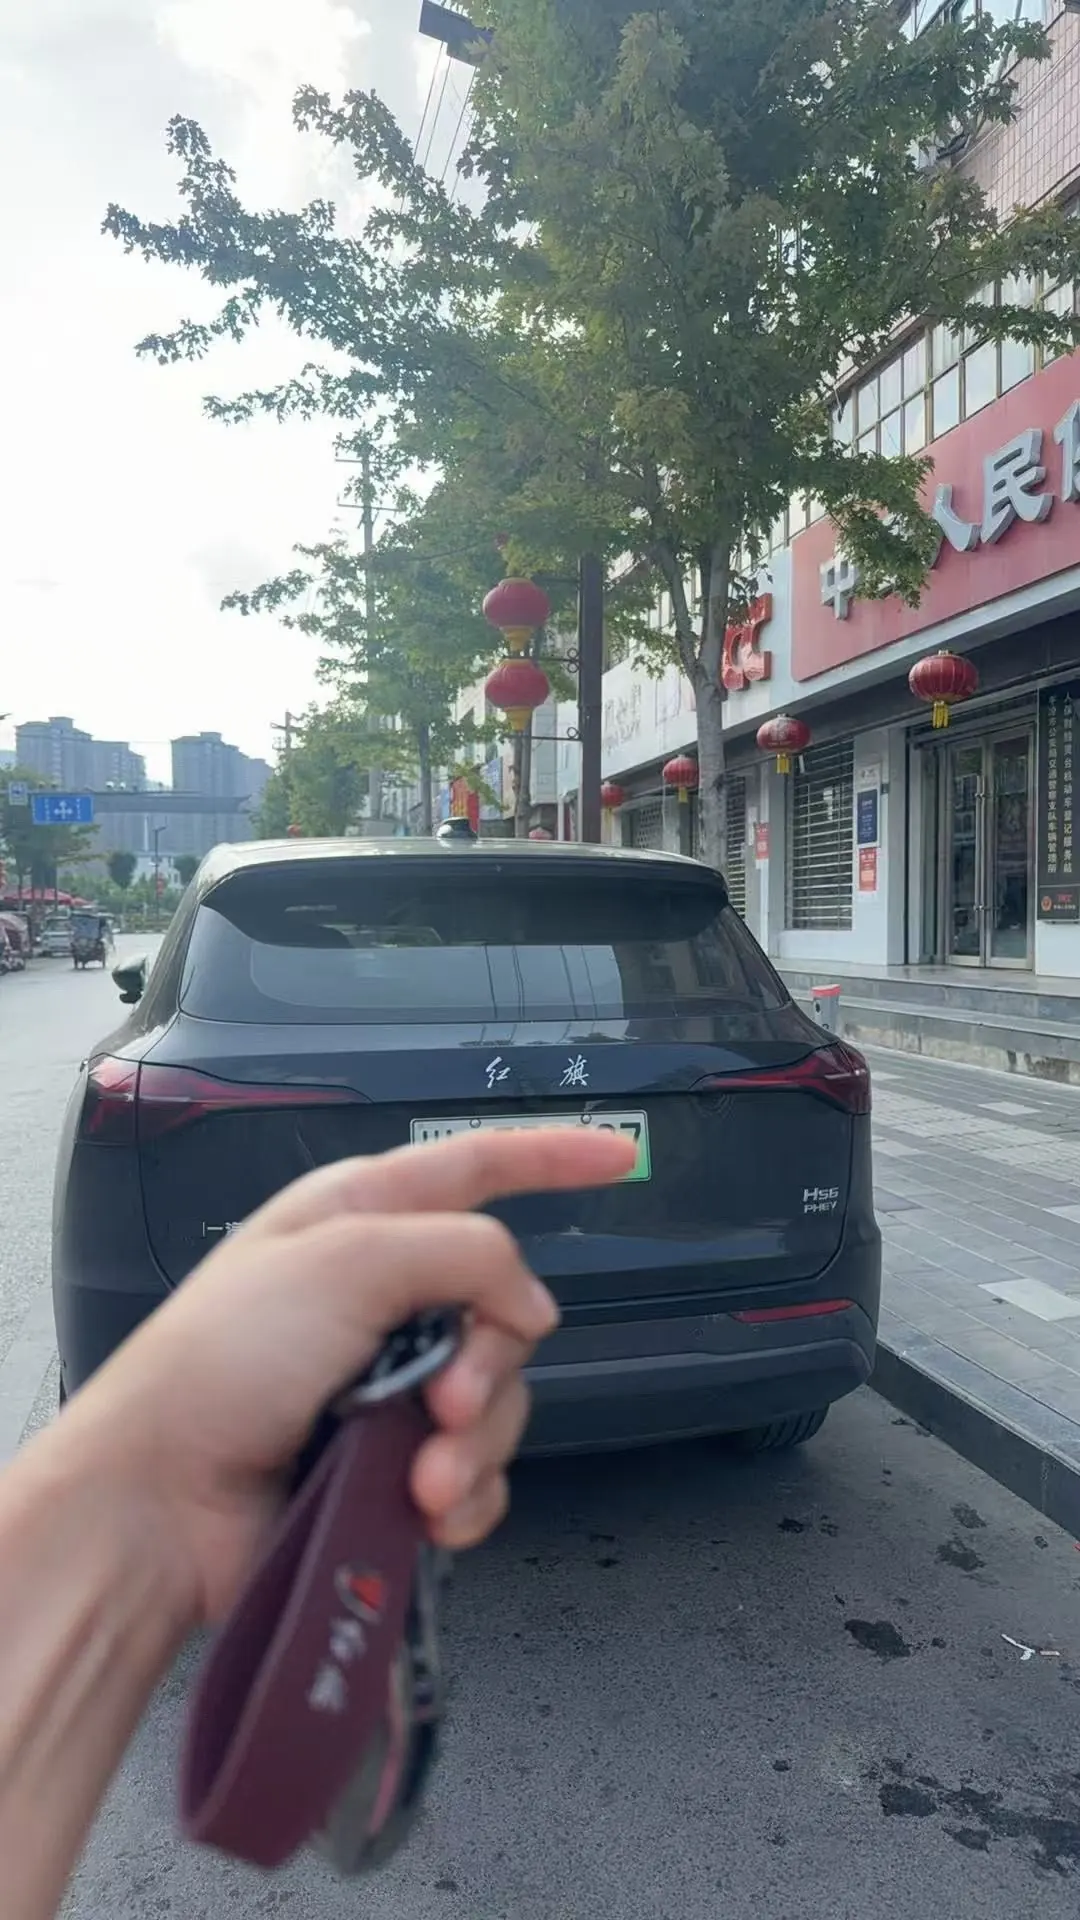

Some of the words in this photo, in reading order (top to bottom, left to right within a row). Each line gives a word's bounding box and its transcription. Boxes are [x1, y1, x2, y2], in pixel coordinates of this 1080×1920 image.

[818, 398, 1080, 622] 中人民
[485, 1054, 590, 1089] 红旗
[802, 1187, 840, 1202] HS6
[803, 1200, 838, 1214] PHEV
